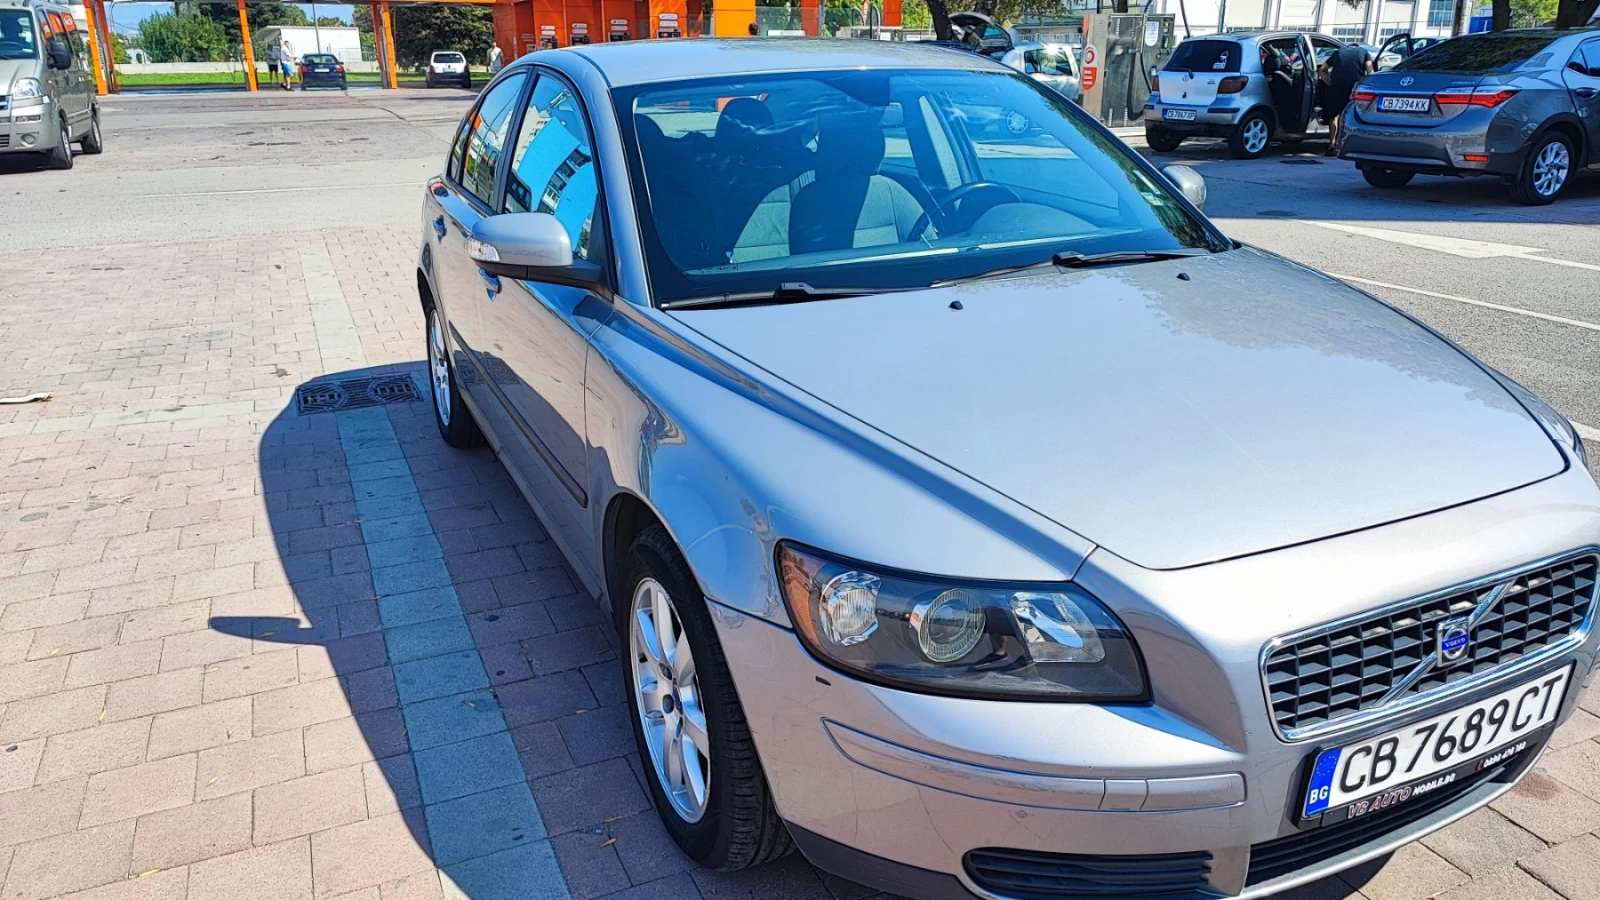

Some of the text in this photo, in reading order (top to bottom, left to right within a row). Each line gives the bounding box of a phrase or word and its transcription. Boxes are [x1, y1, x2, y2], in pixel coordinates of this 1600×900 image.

[1340, 674, 1563, 793] CB 7689 CT
[1309, 786, 1329, 804] BG
[1368, 786, 1412, 812] AUTO
